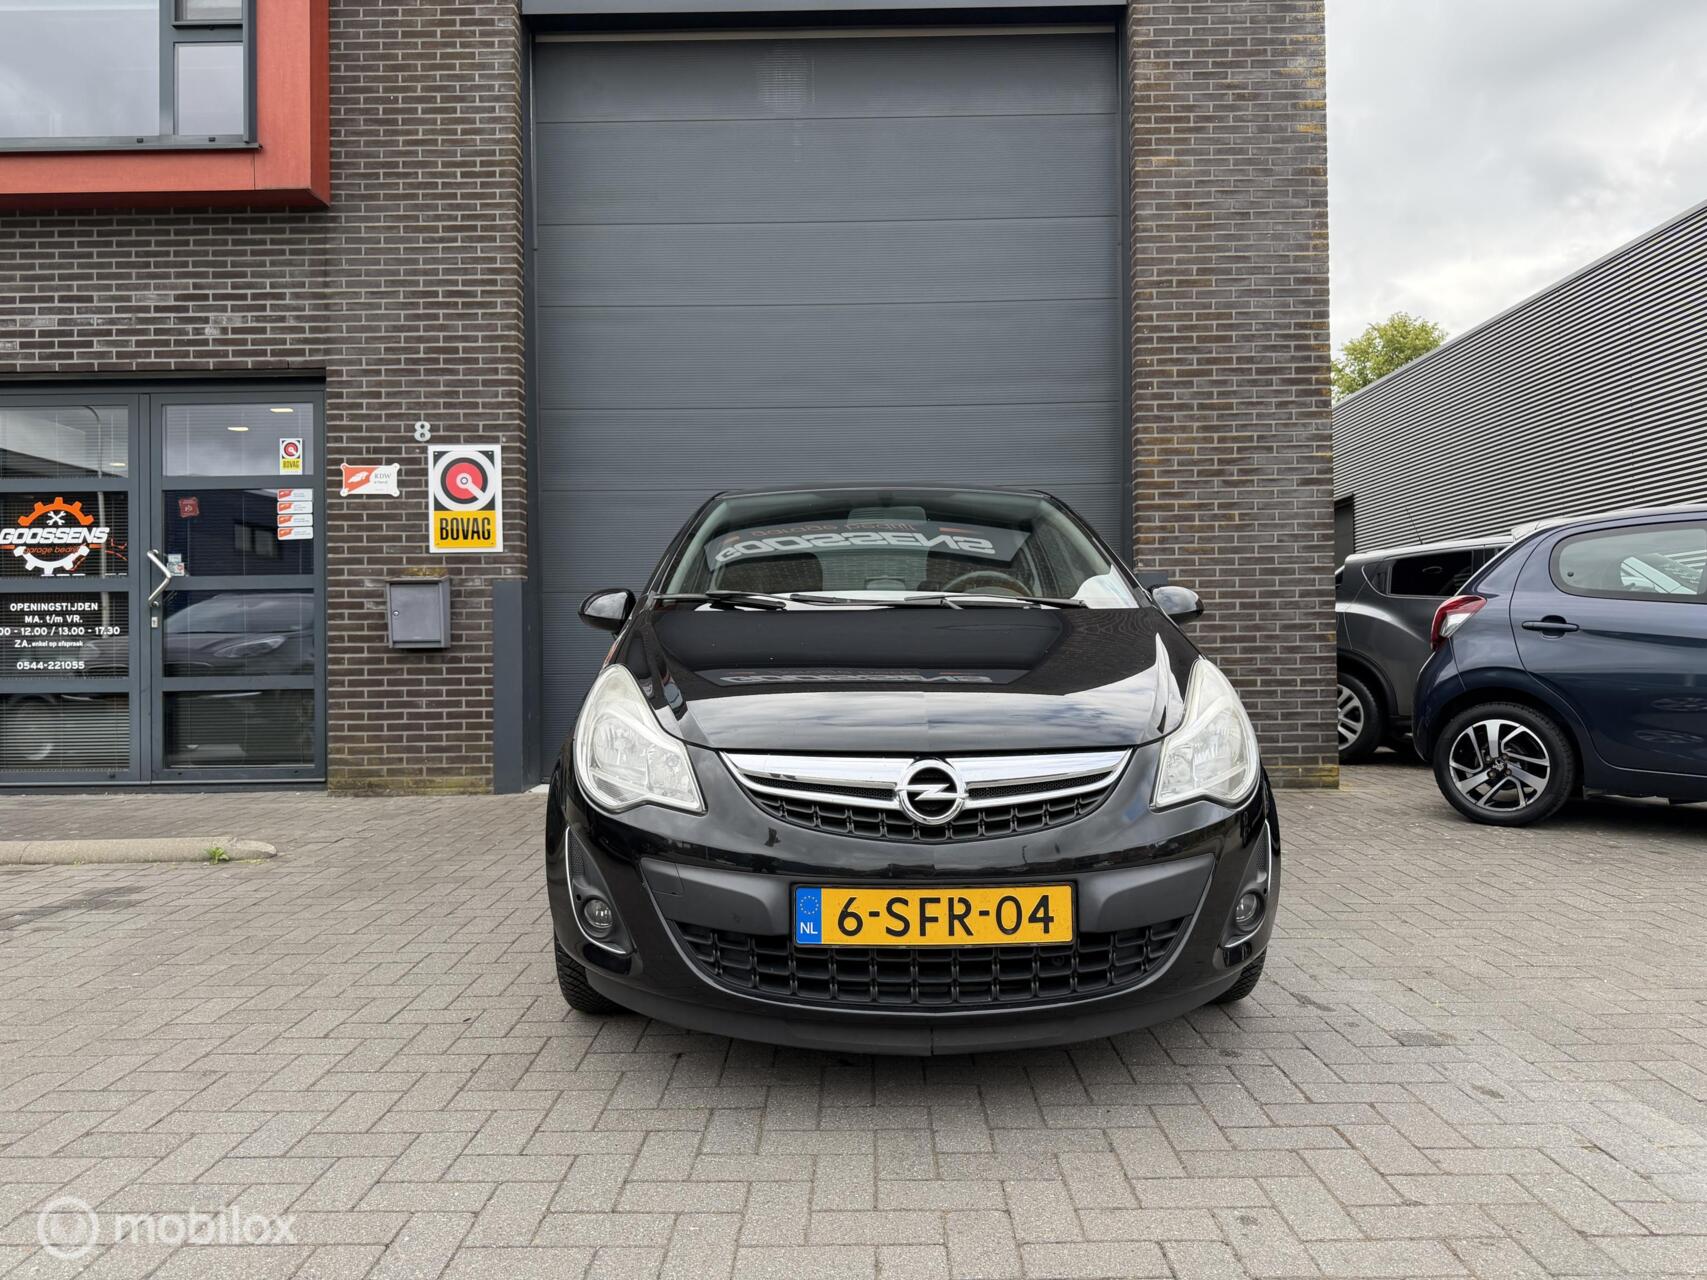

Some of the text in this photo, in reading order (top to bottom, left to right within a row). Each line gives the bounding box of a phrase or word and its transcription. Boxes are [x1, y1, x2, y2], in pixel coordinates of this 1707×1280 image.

[414, 421, 431, 442] 8
[0, 527, 110, 544] GOOSSENS
[439, 517, 491, 541] BOVAG
[10, 603, 98, 611] OPENINGSTIJDEN
[24, 615, 83, 624] MA. t/m VR.
[20, 627, 48, 635] 12.00
[59, 627, 85, 635] 13.00
[95, 626, 120, 635] 17.30
[17, 661, 85, 670] 0544-221055
[837, 894, 1055, 937] 6-SFR-04
[800, 921, 818, 935] NL
